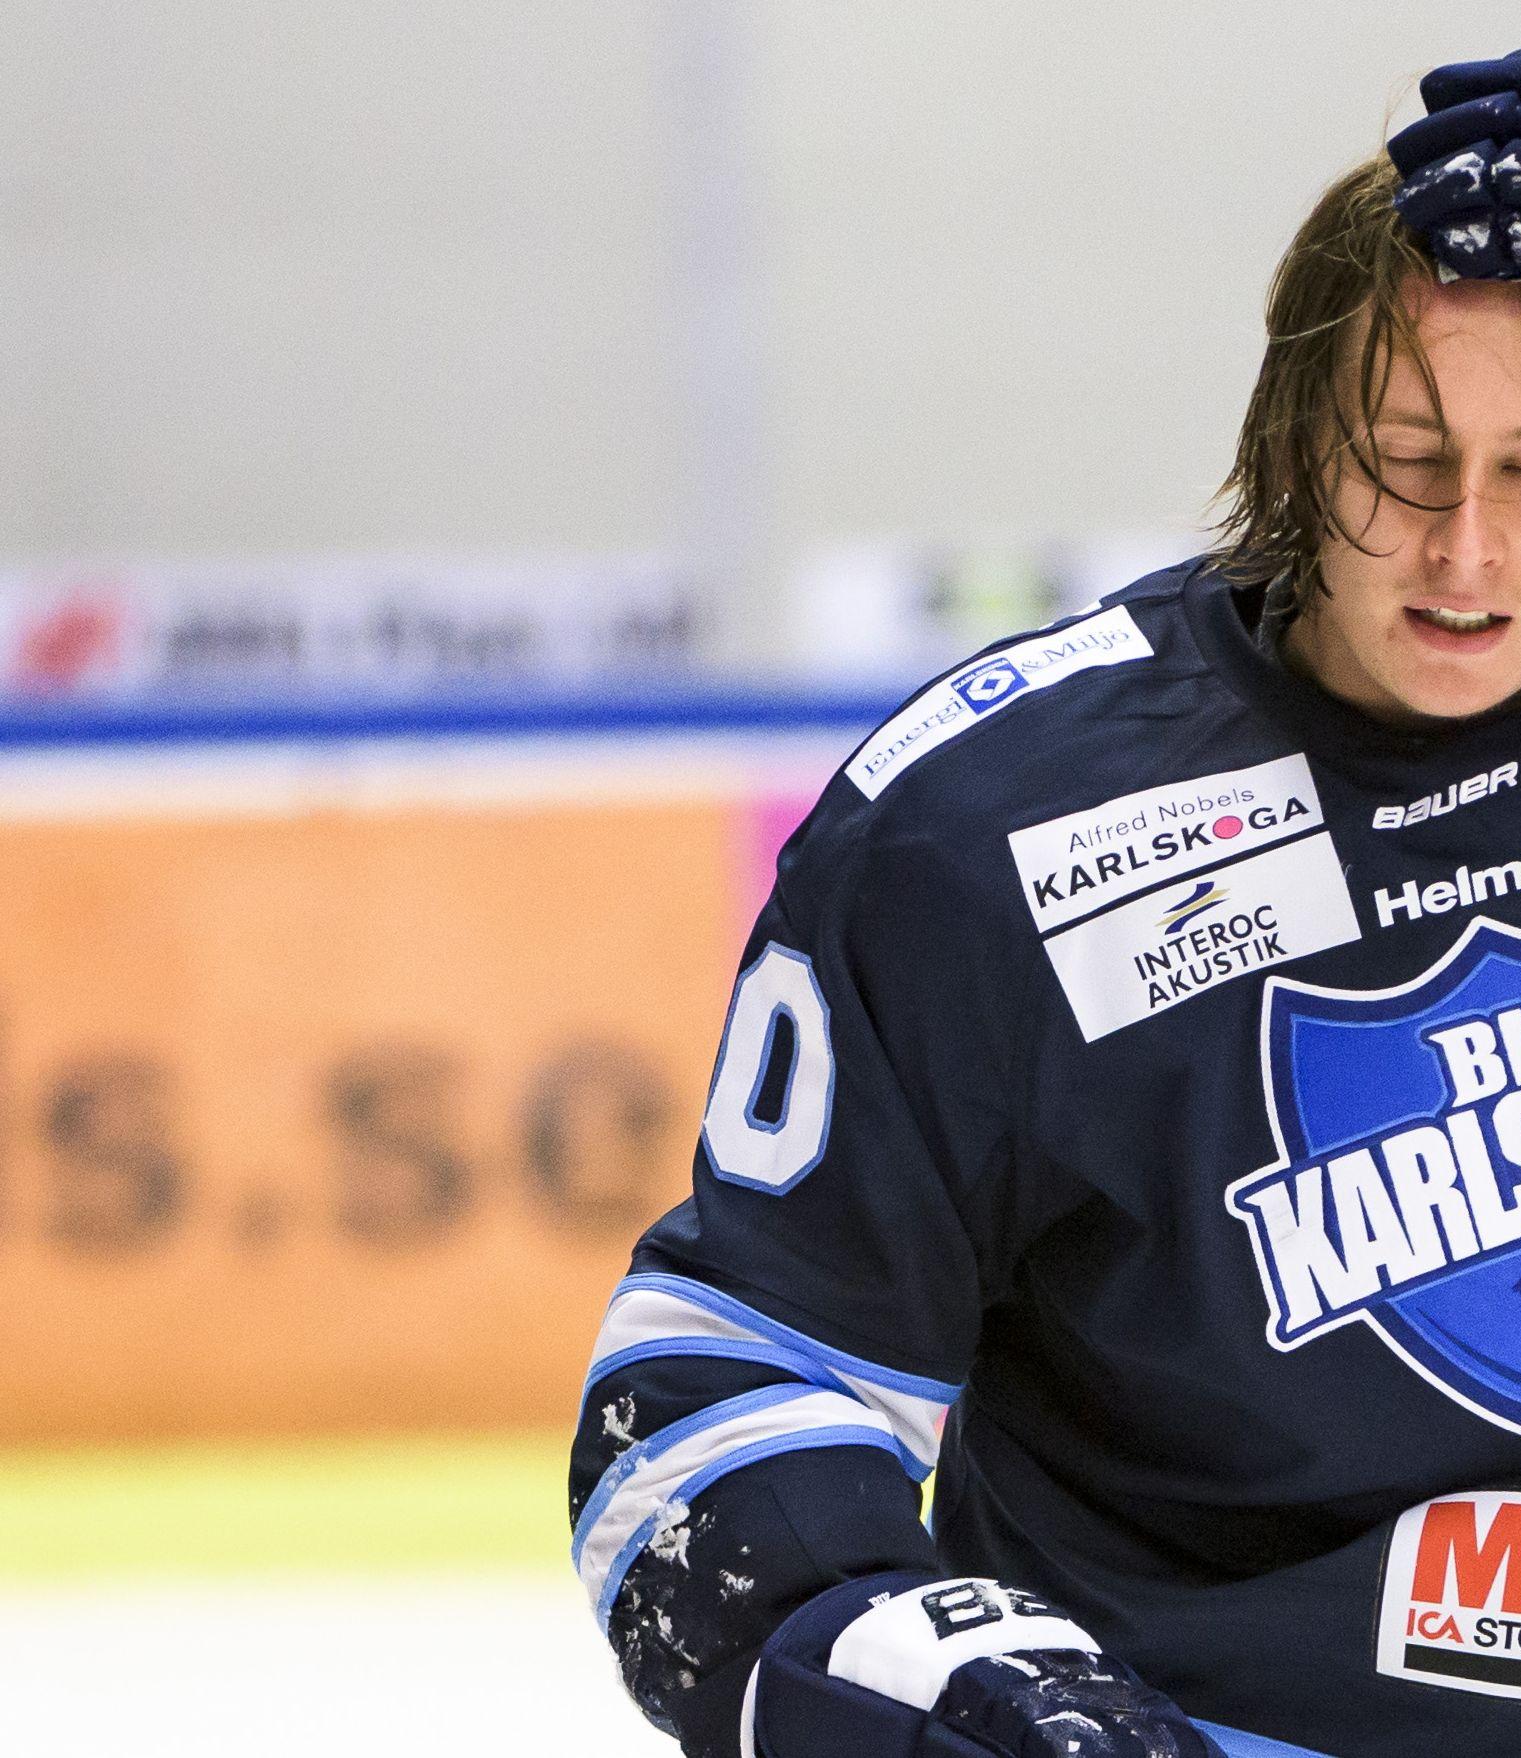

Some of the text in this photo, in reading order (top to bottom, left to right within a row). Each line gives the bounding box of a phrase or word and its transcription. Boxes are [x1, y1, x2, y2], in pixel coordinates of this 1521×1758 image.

[864, 629, 1130, 776] Energi & Miljö
[1069, 788, 1256, 852] Alfred Nobels
[1372, 762, 1519, 830] BAUER
[1032, 797, 1310, 909] KARLSKOGA
[1134, 905, 1277, 981] INTEROC
[1149, 932, 1288, 1009] AKUSTIK
[1406, 1608, 1463, 1644] ICA
